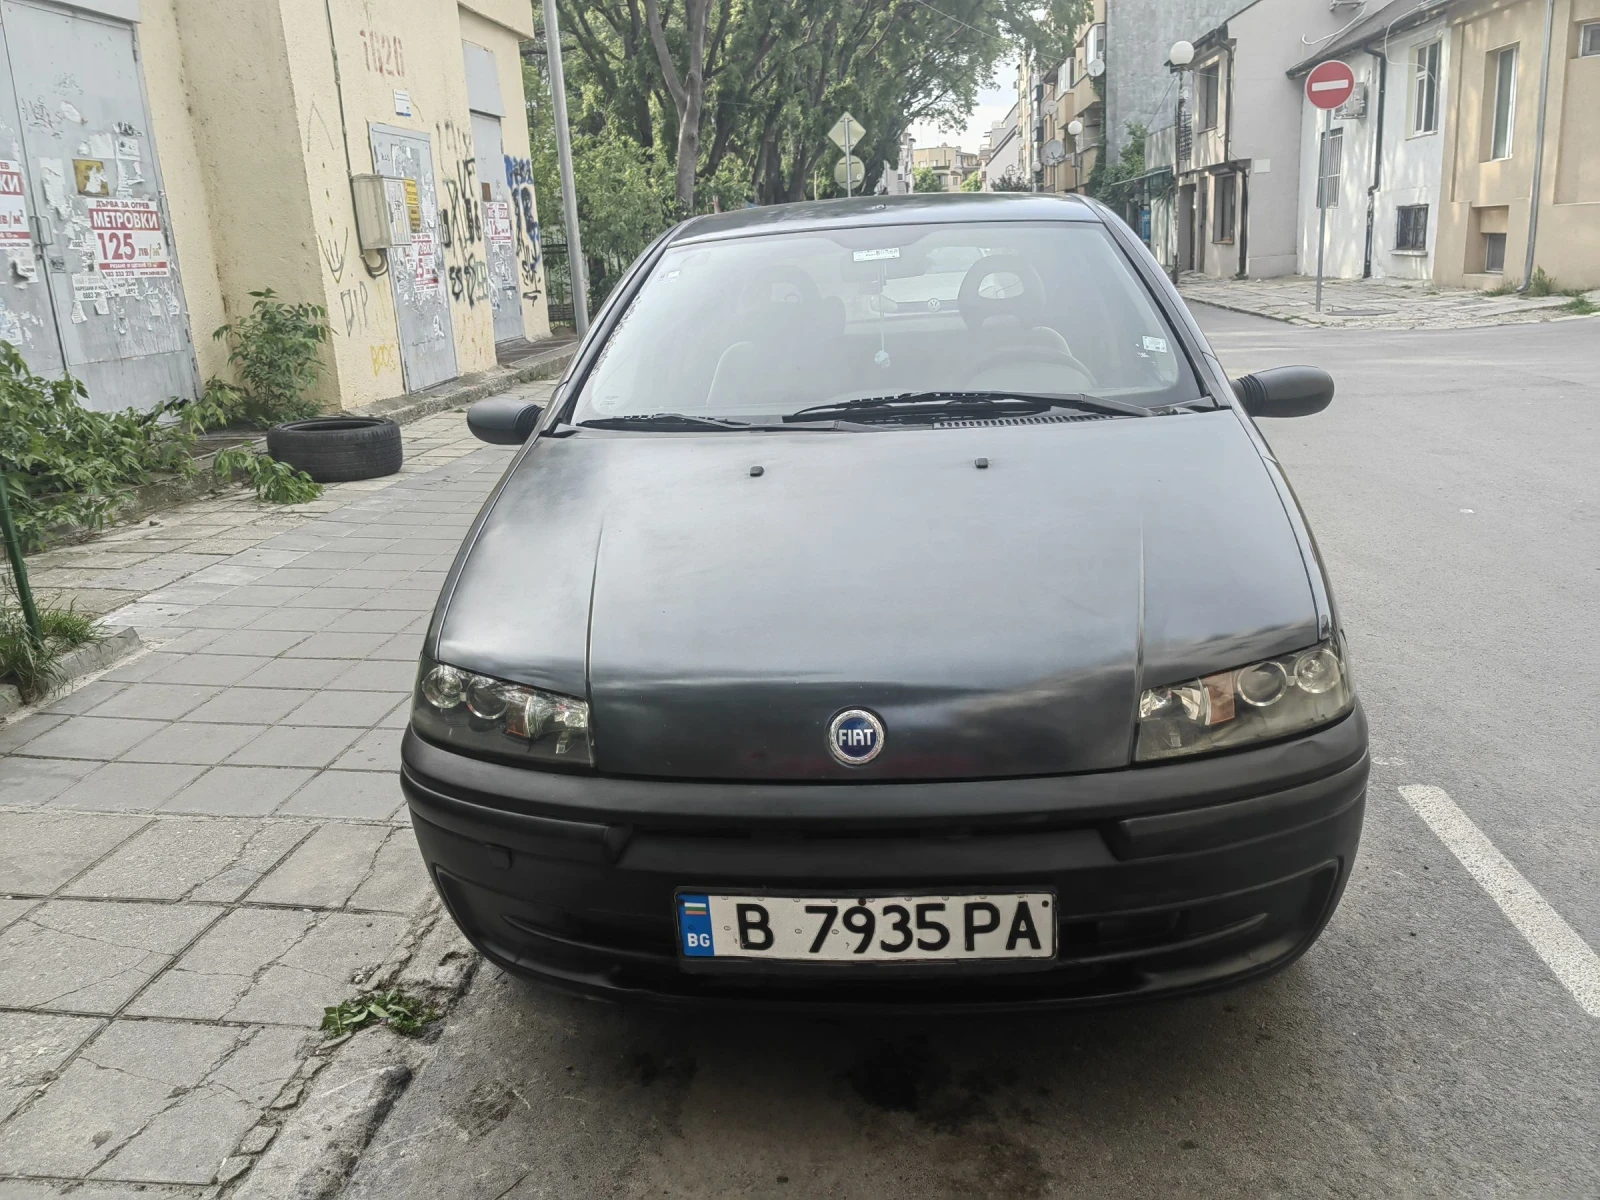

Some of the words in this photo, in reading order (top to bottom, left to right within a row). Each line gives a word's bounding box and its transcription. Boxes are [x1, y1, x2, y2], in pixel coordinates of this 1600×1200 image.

[96, 200, 119, 208] ДЪРВА
[92, 211, 158, 229] МЕТРОВКИ
[97, 232, 136, 260] 125
[838, 728, 873, 746] FIAT
[736, 903, 775, 950] B
[804, 902, 950, 954] 7935
[964, 900, 1043, 952] PA
[687, 933, 710, 948] BG
